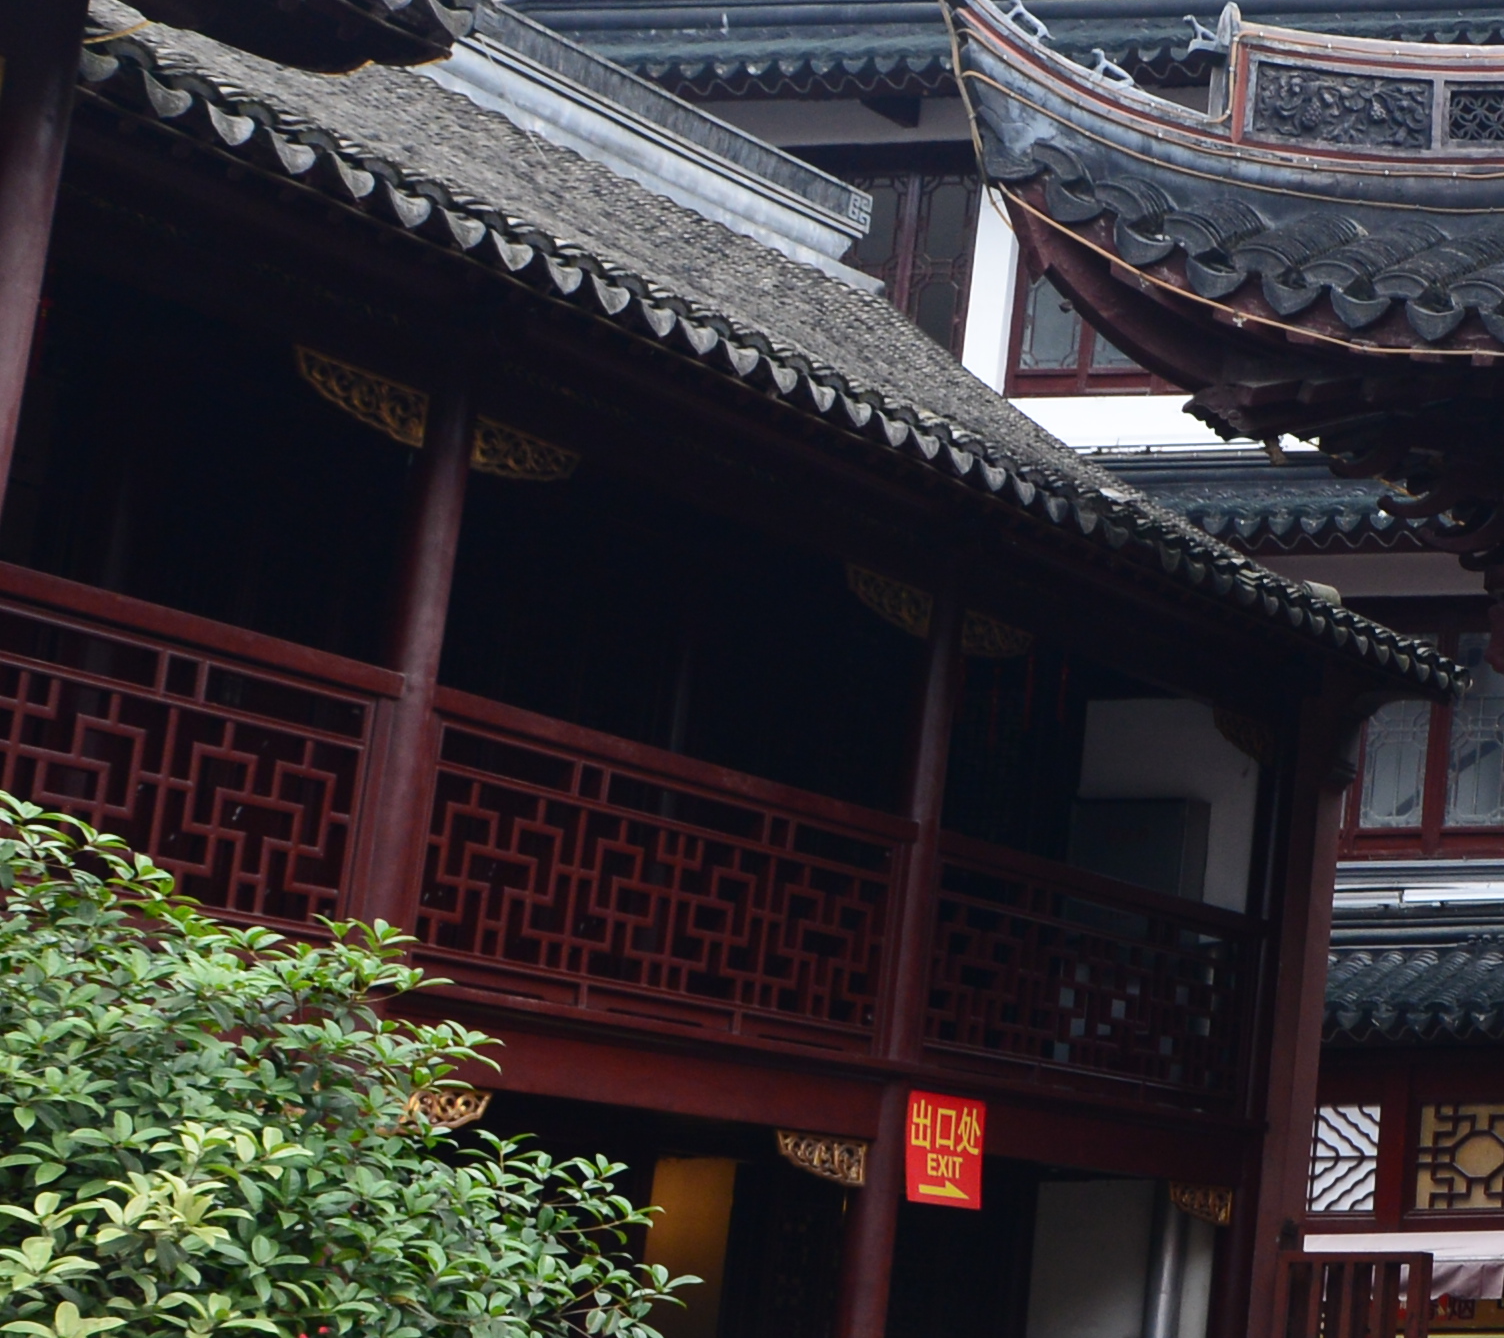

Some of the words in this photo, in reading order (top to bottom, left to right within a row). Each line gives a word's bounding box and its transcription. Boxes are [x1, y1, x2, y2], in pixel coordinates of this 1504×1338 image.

[911, 1099, 981, 1156] 出口处
[927, 1153, 963, 1179] EXIT
